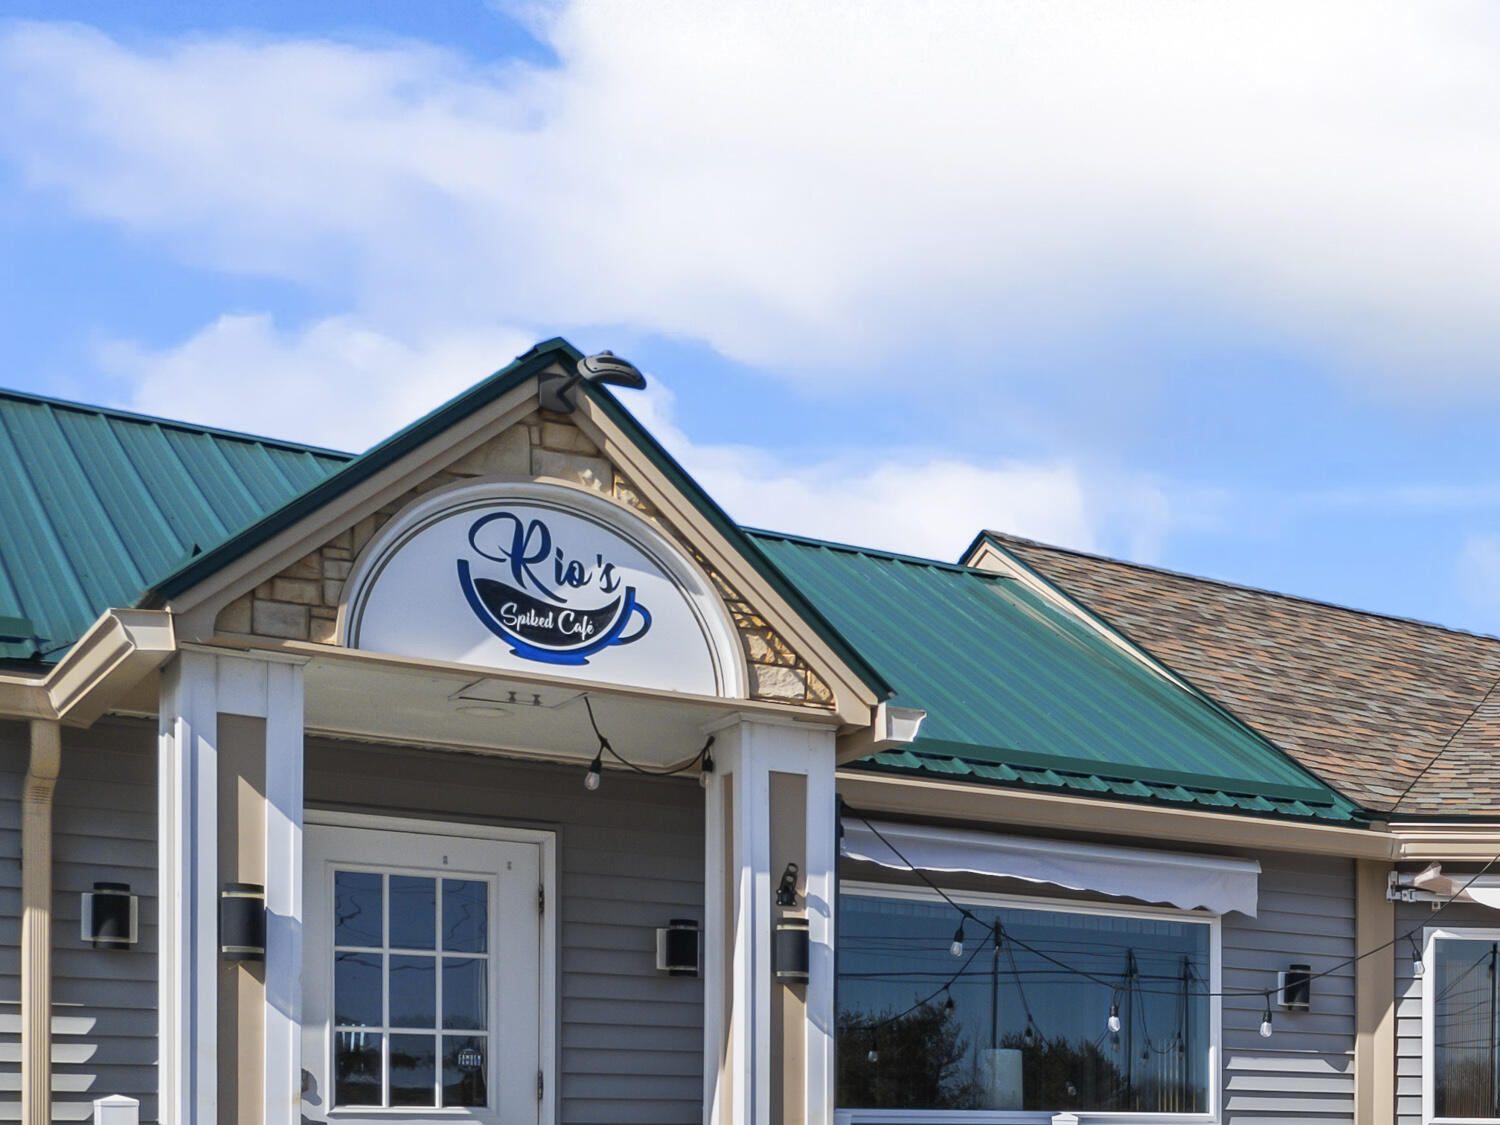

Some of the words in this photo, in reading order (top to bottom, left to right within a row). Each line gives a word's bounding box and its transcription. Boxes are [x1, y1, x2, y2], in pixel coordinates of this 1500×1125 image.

[468, 511, 621, 604] Rio's
[500, 602, 554, 631] Spiked
[557, 610, 595, 641] Café
